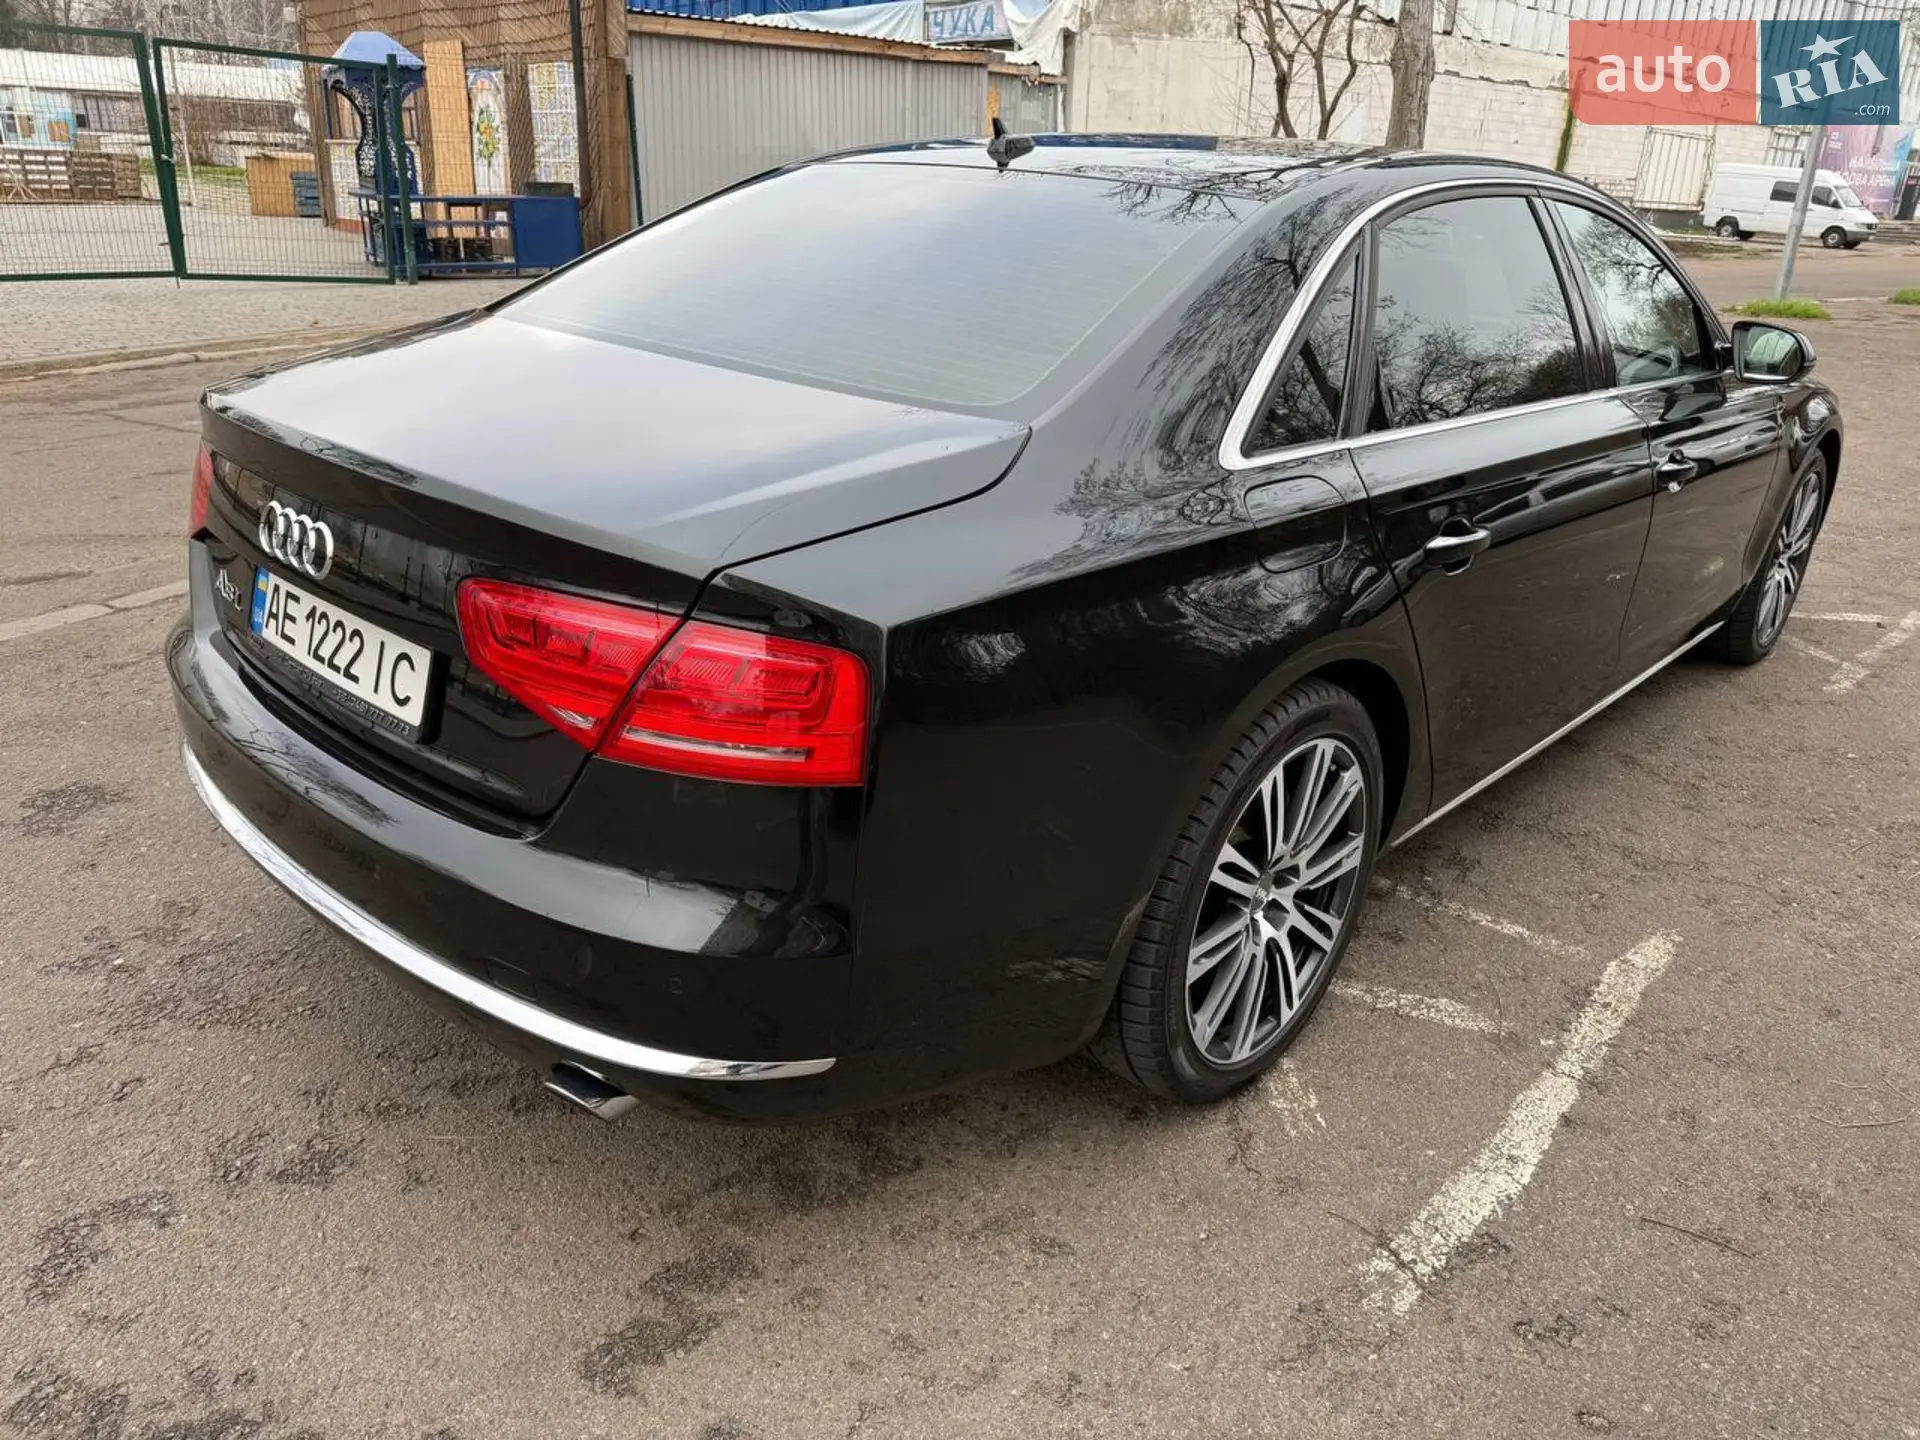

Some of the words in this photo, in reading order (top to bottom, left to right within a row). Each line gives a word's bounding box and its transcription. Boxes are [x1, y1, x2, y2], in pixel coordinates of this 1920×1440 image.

[932, 4, 995, 36] ЧУКА
[265, 583, 301, 646] AE
[305, 605, 365, 685] 1222
[373, 640, 416, 708] IC
